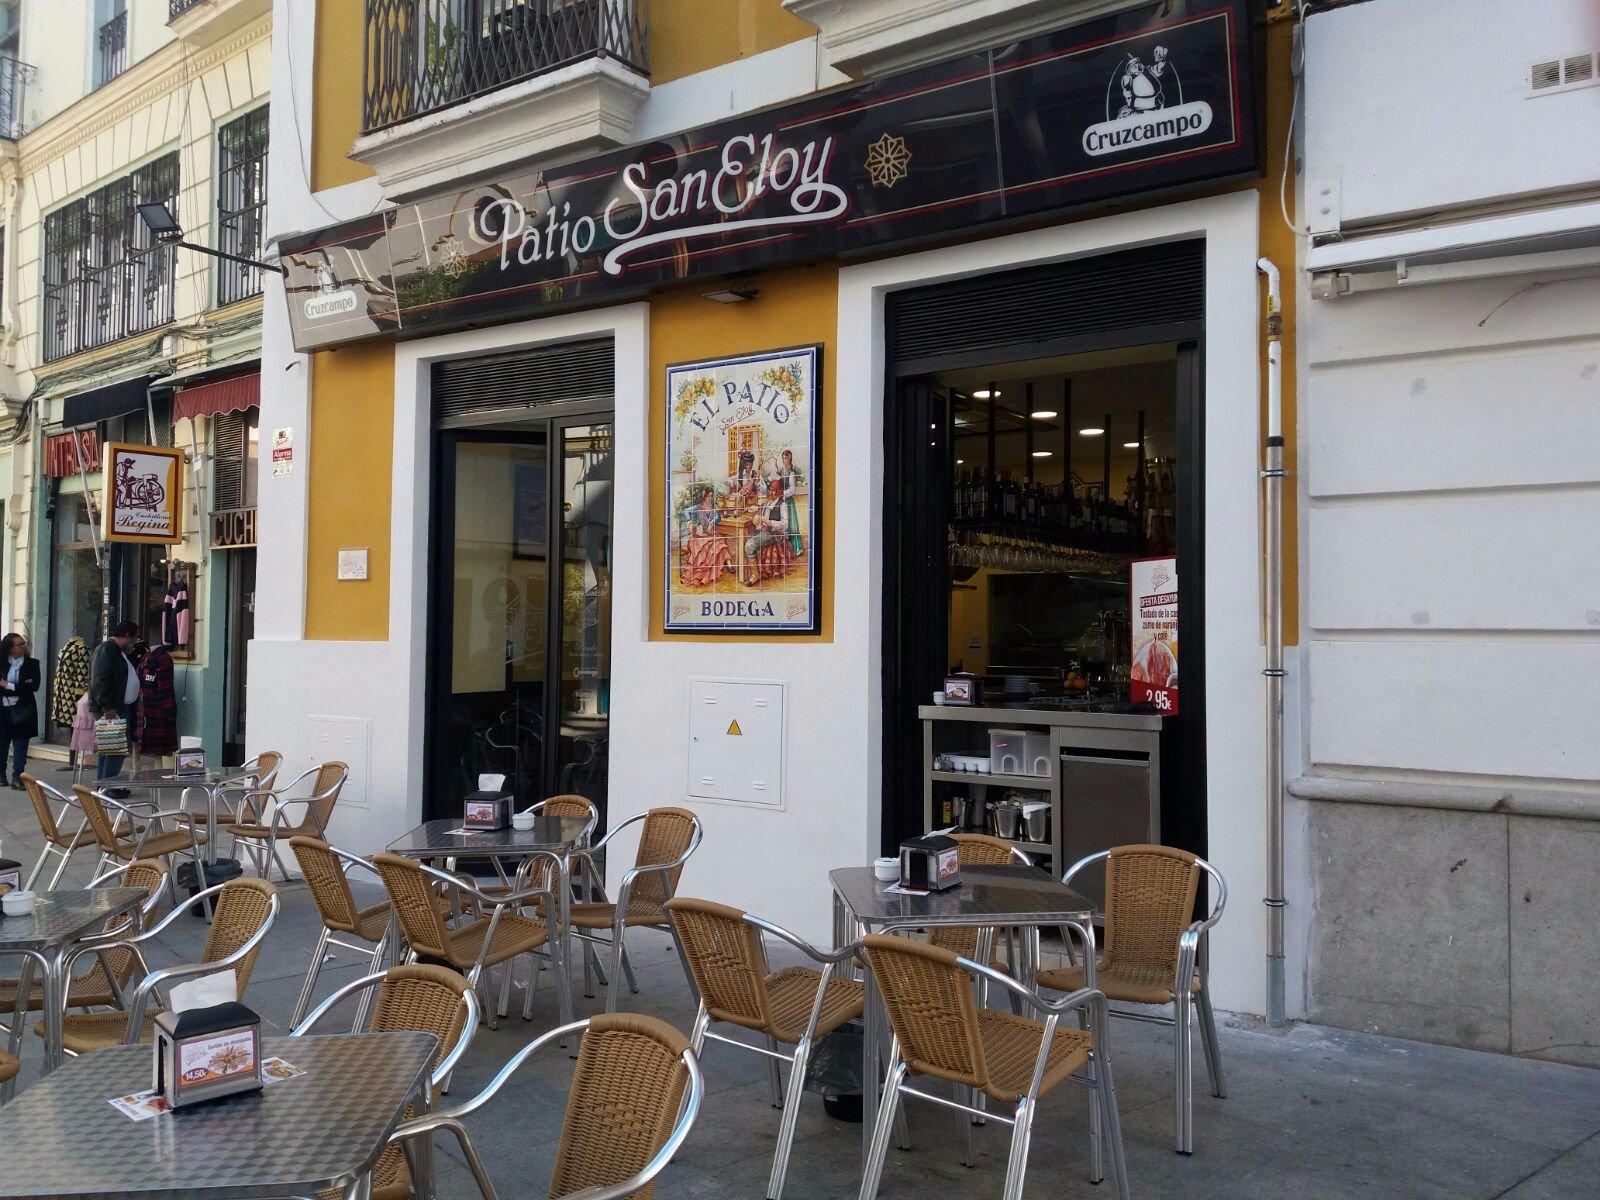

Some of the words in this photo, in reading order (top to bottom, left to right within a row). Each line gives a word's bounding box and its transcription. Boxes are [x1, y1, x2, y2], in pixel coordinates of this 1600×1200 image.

[1086, 113, 1203, 152] Cruzcampo
[479, 198, 597, 271] Patio
[305, 297, 354, 317] Cruzcampo
[690, 398, 720, 432] EL
[722, 380, 790, 424] PATIO
[116, 515, 171, 533] Regina
[701, 600, 775, 618] BODEGA
[1140, 595, 1158, 608] OFERTA
[1140, 609, 1158, 618] Tostada
[1158, 609, 1164, 618] de
[1165, 608, 1170, 618] la
[1142, 621, 1155, 630] zumo
[1156, 620, 1161, 630] de
[1157, 630, 1168, 641] café
